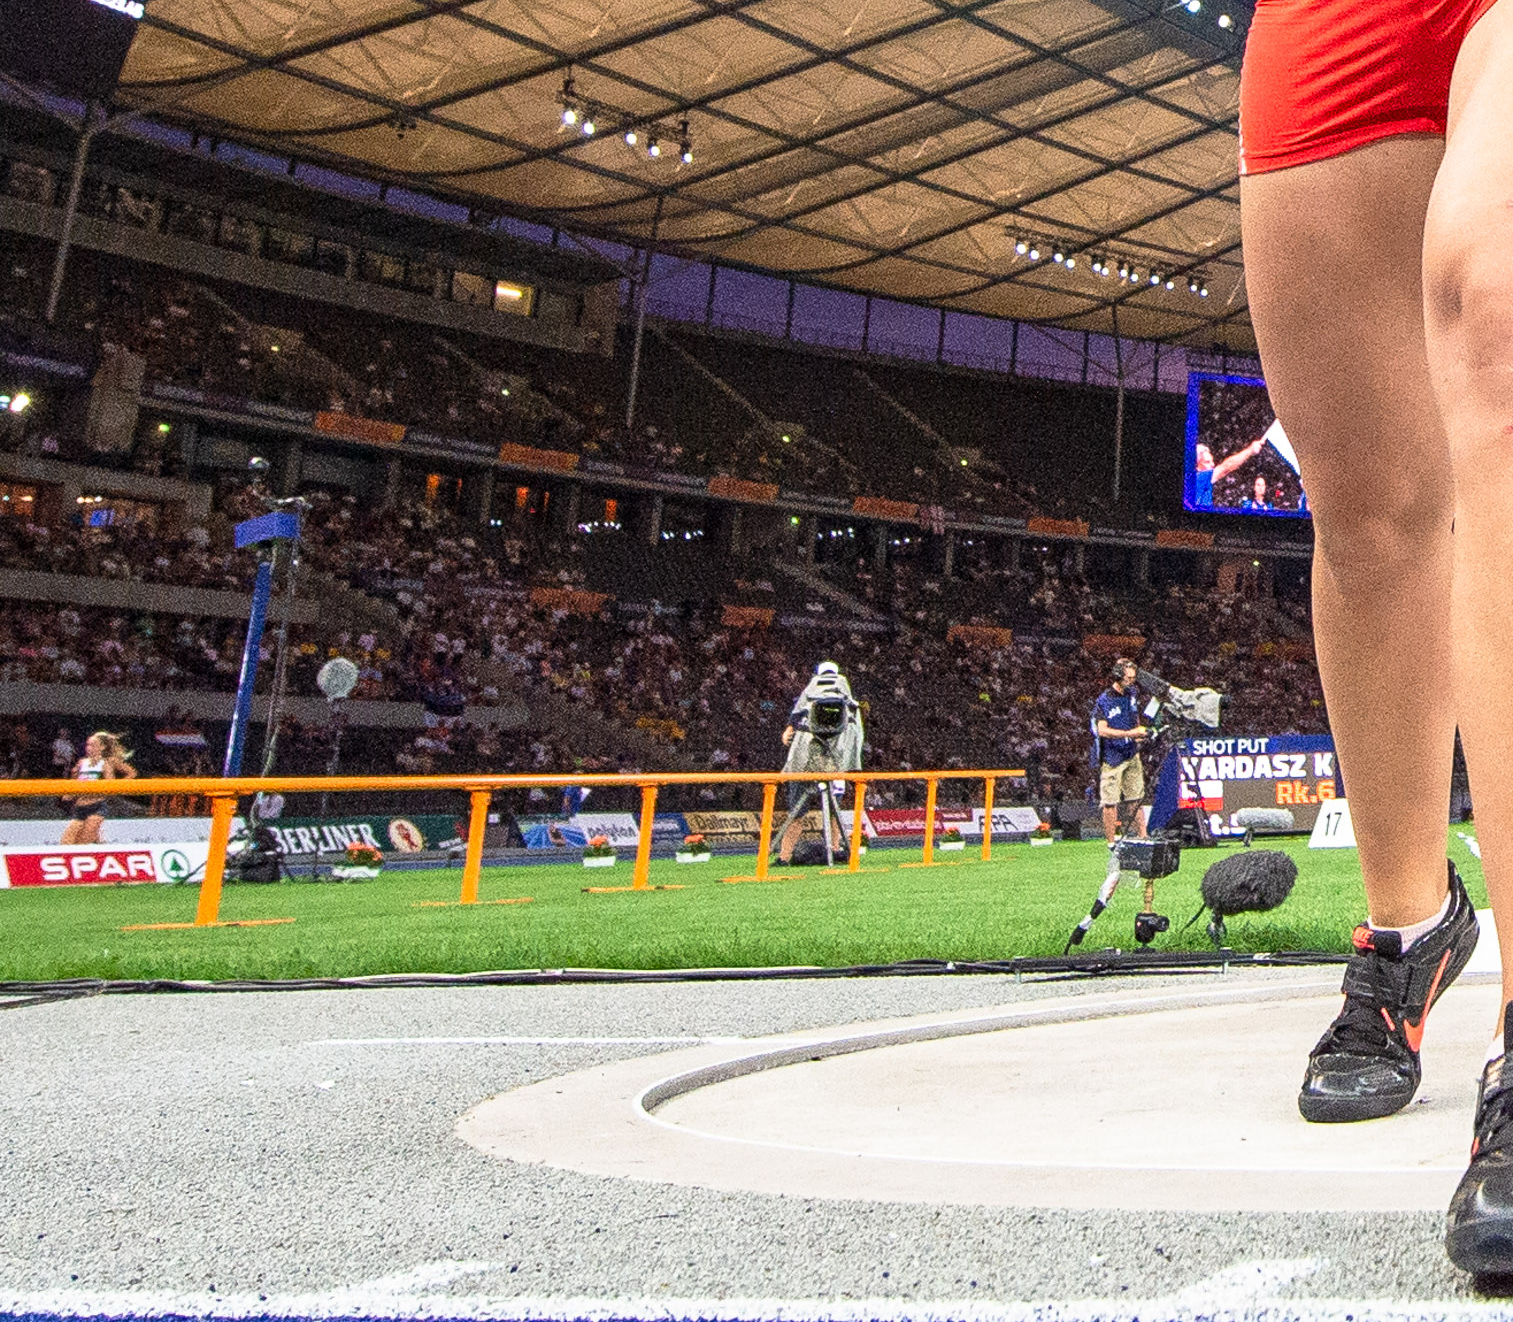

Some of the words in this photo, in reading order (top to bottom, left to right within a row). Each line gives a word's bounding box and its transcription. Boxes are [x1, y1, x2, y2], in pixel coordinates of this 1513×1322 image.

[1193, 739, 1235, 755] SHOT
[1237, 738, 1269, 754] PUT
[1314, 752, 1334, 777] K
[1275, 779, 1337, 805] Rk.6
[1325, 811, 1343, 837] 17
[40, 854, 154, 881] SPAR
